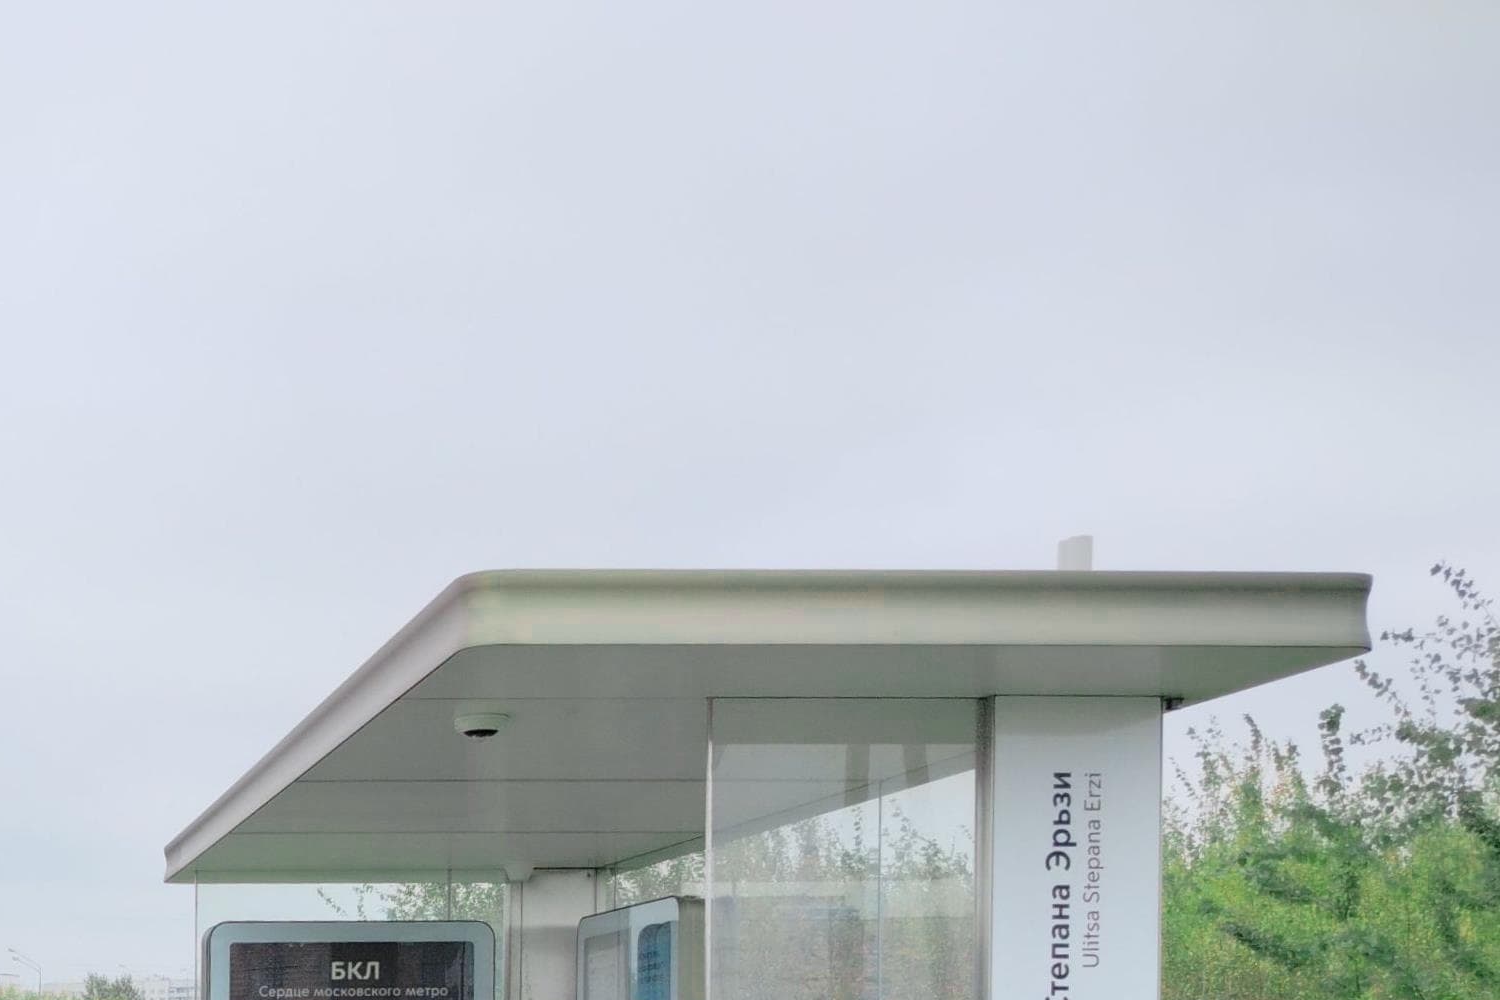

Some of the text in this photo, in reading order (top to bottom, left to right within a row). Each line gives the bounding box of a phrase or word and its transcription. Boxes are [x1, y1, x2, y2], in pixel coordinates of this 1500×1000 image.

[1045, 771, 1077, 871] Эрьзи
[1081, 772, 1104, 968] Ulitsa Stepana Erzi
[258, 985, 449, 999] Сердце московского метро
[331, 961, 380, 980] БКЛ
